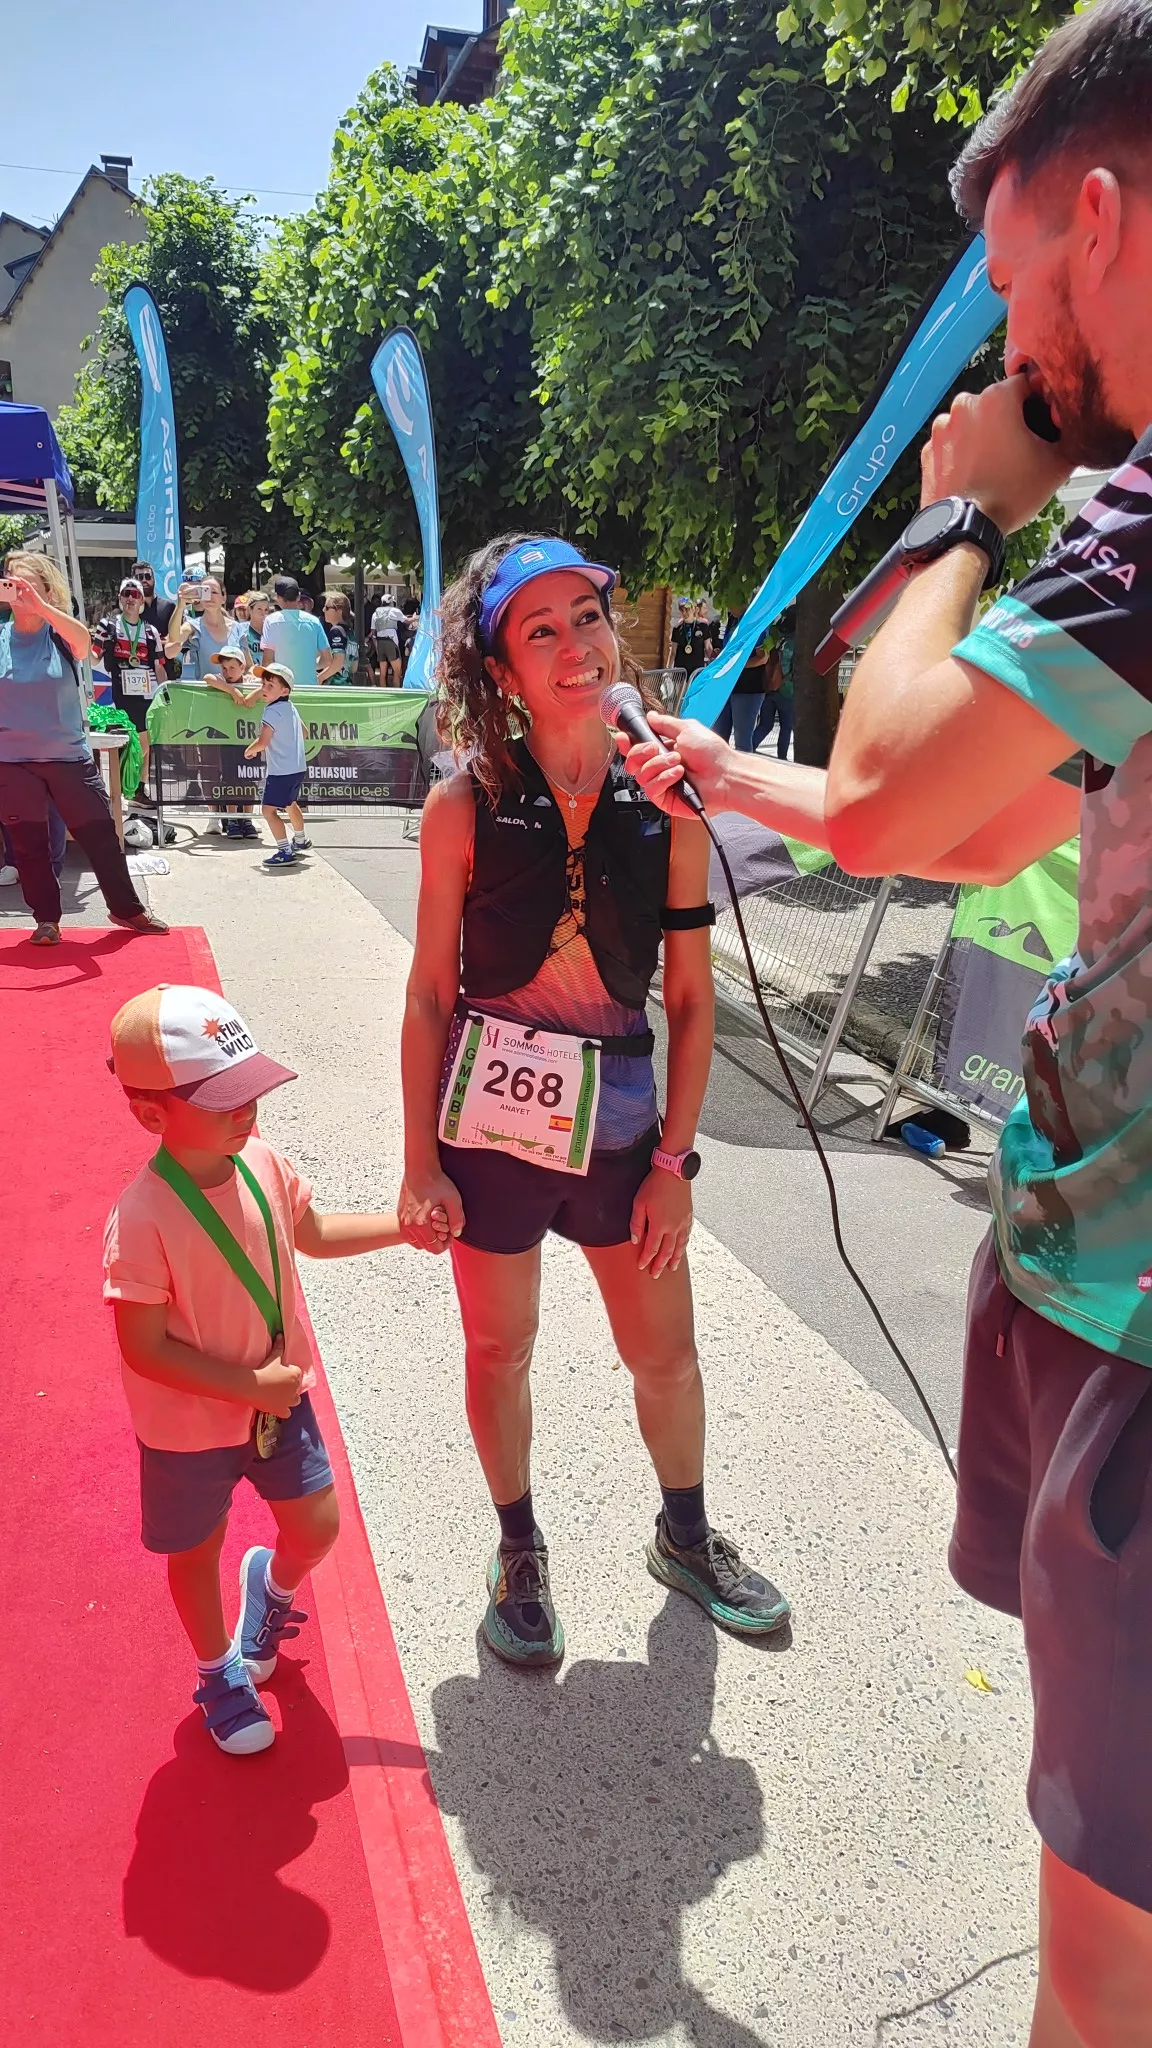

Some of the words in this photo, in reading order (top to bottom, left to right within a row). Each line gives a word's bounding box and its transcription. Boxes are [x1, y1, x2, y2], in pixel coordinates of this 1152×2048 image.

[836, 424, 897, 518] Grupo
[127, 676, 147, 684] 1370
[308, 765, 358, 780] BENASQUE
[218, 1019, 244, 1042] FUN
[220, 1033, 254, 1059] WILD
[503, 1037, 545, 1055] SOMMOS
[546, 1049, 582, 1062] HOTELES
[482, 1059, 564, 1109] 268
[499, 1103, 532, 1116] ANAYET
[574, 1060, 593, 1154] granmaratonbenasque.es
